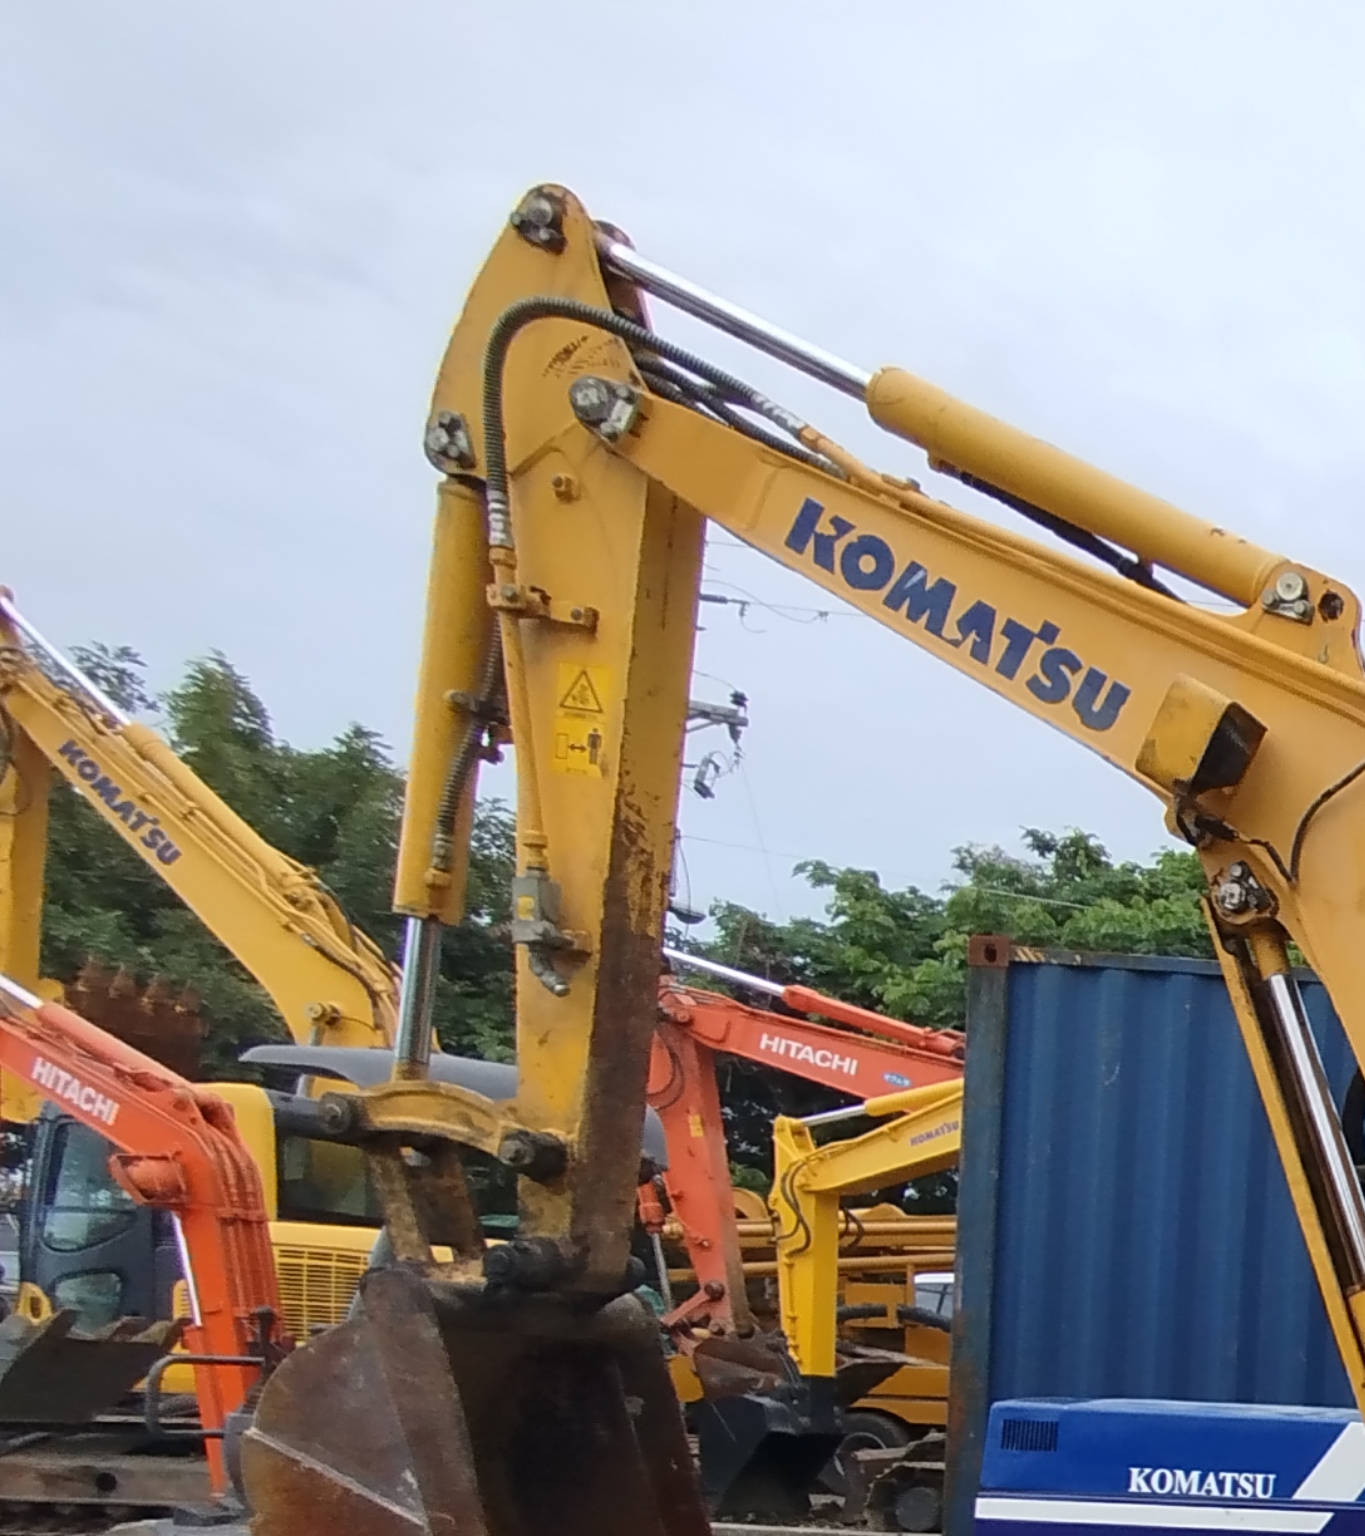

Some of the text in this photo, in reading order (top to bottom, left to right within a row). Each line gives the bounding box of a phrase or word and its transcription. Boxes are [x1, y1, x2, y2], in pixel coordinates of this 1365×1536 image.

[784, 497, 1132, 731] KOMATSU
[57, 739, 182, 866] KOMATSU
[759, 1033, 860, 1077] HITACHI
[31, 1056, 120, 1126] HITACHI
[909, 1121, 960, 1147] KOMATSU
[1128, 1467, 1276, 1499] KOMATSU
